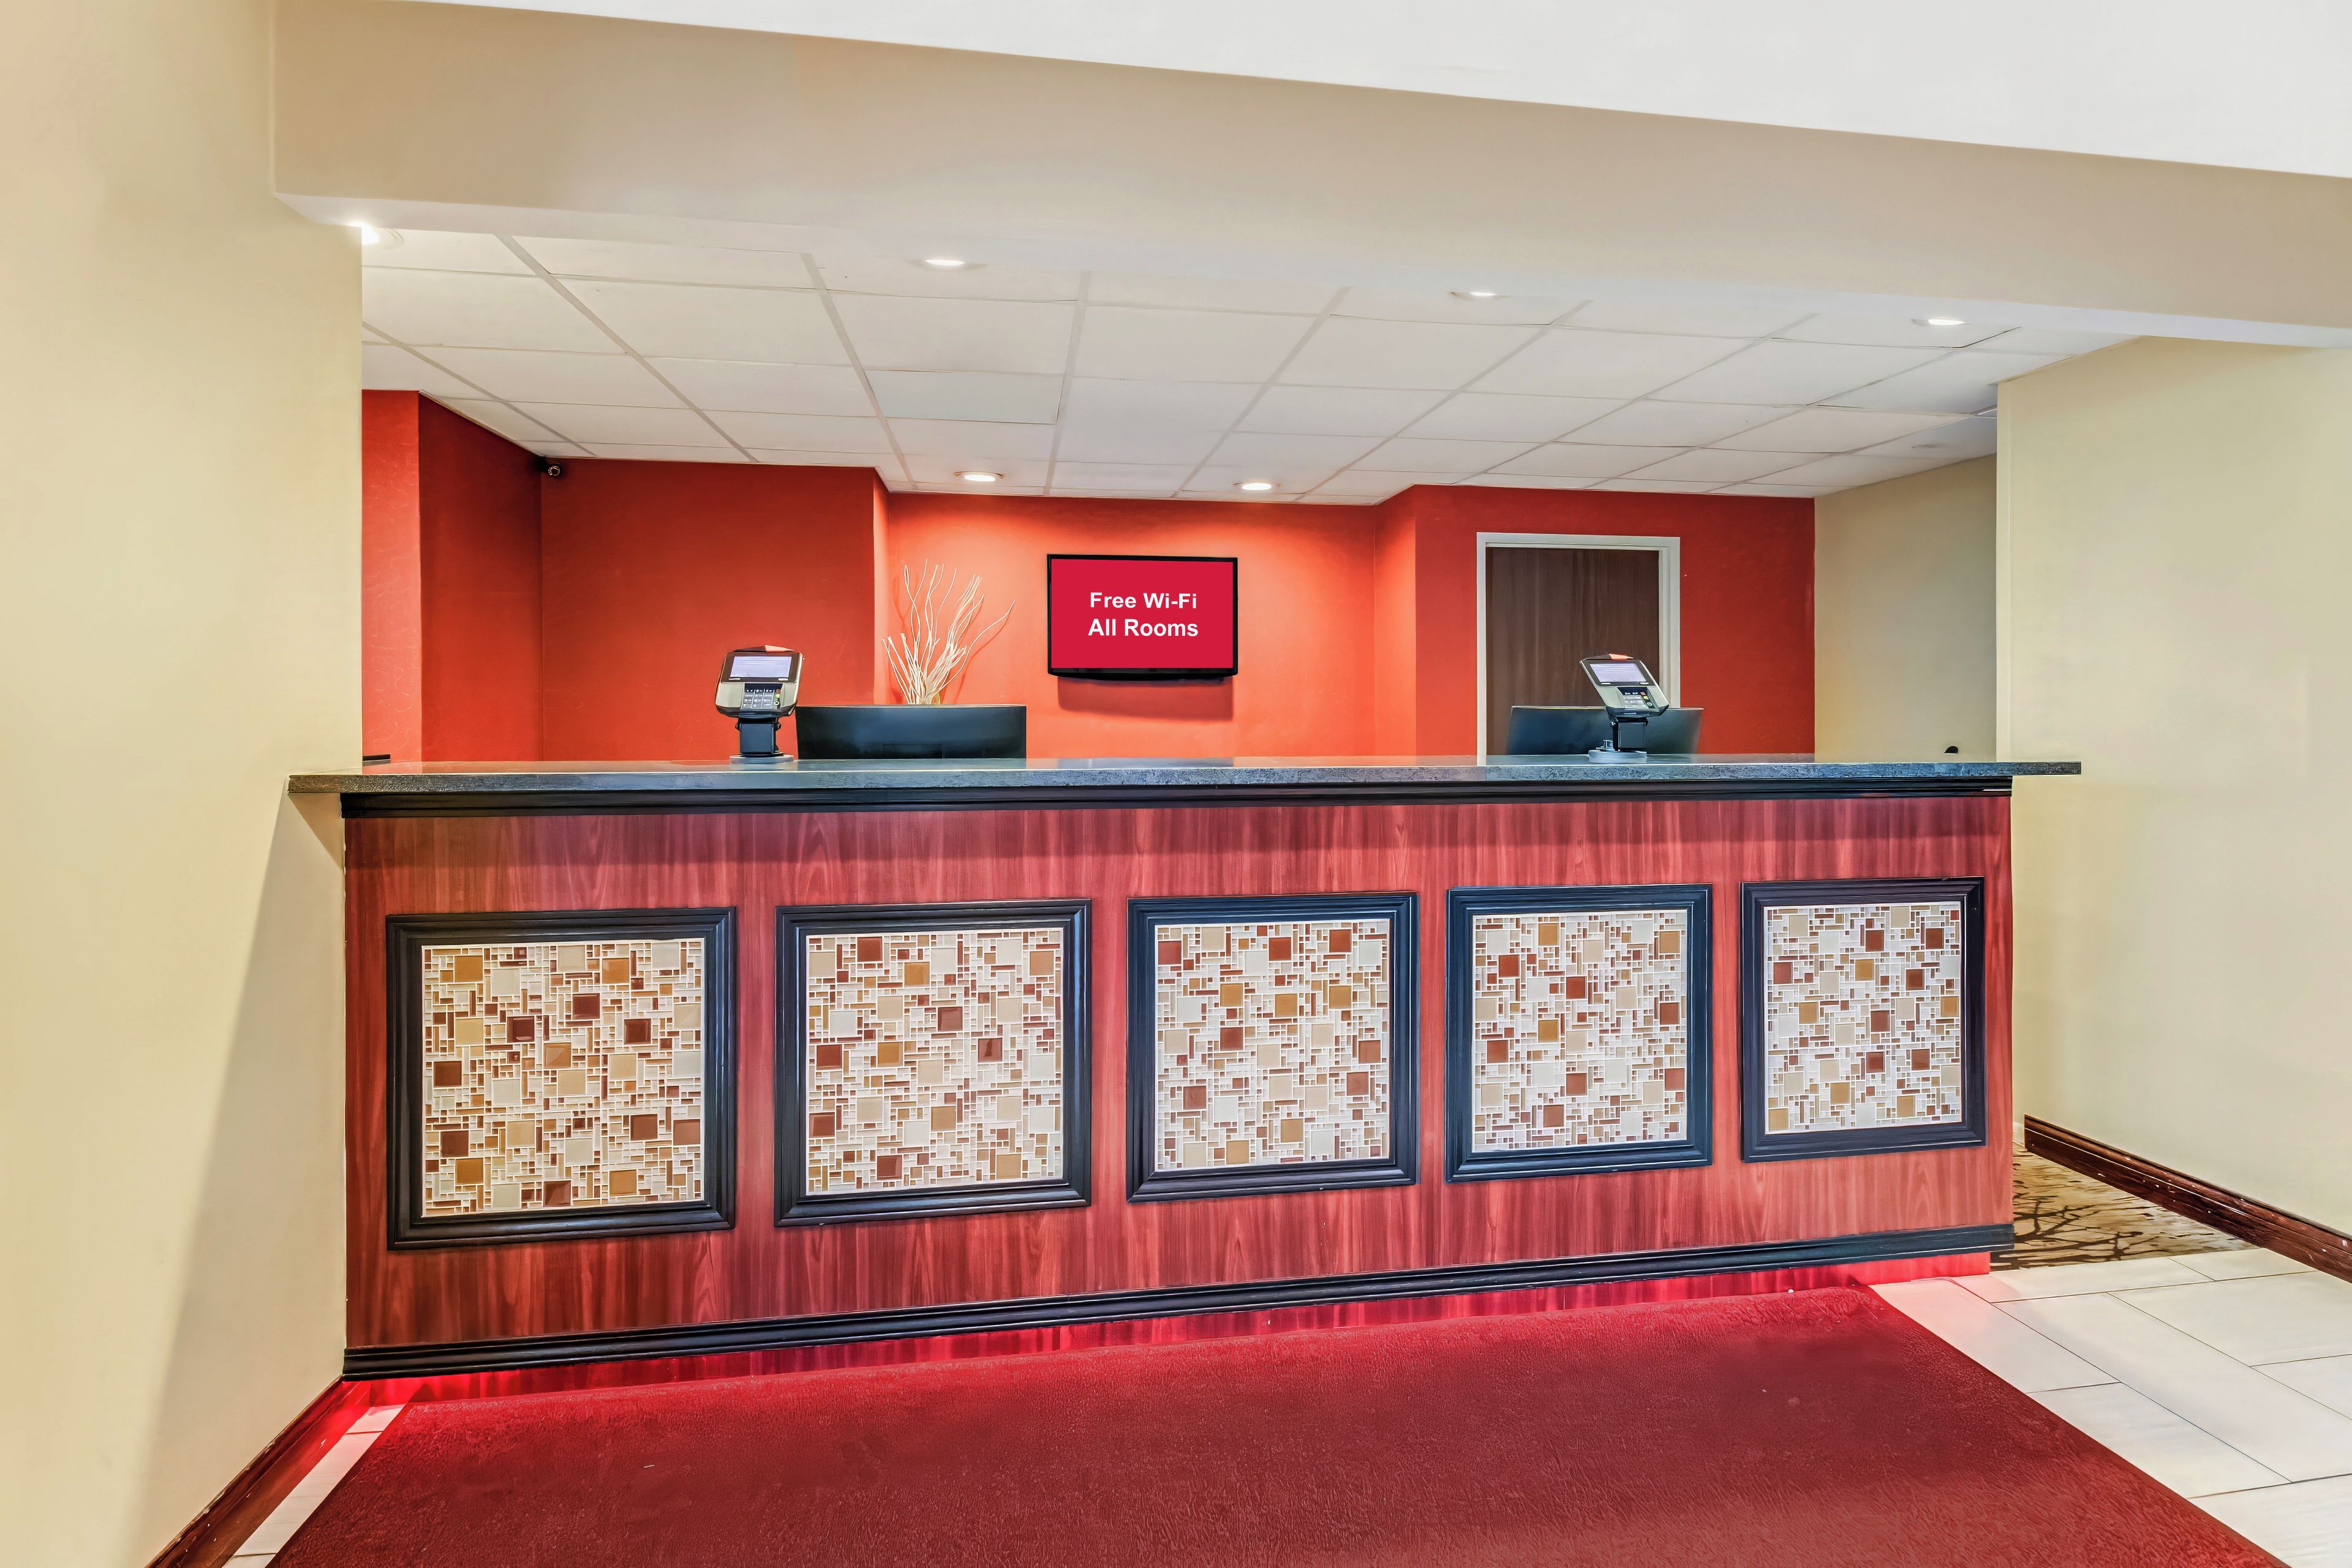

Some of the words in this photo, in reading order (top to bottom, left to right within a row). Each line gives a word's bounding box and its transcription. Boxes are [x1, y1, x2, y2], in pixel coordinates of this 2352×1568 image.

[1090, 592, 1137, 608] Free
[1143, 592, 1197, 609] Wi-Fi
[1088, 618, 1116, 636] All
[1125, 619, 1199, 637] Rooms
